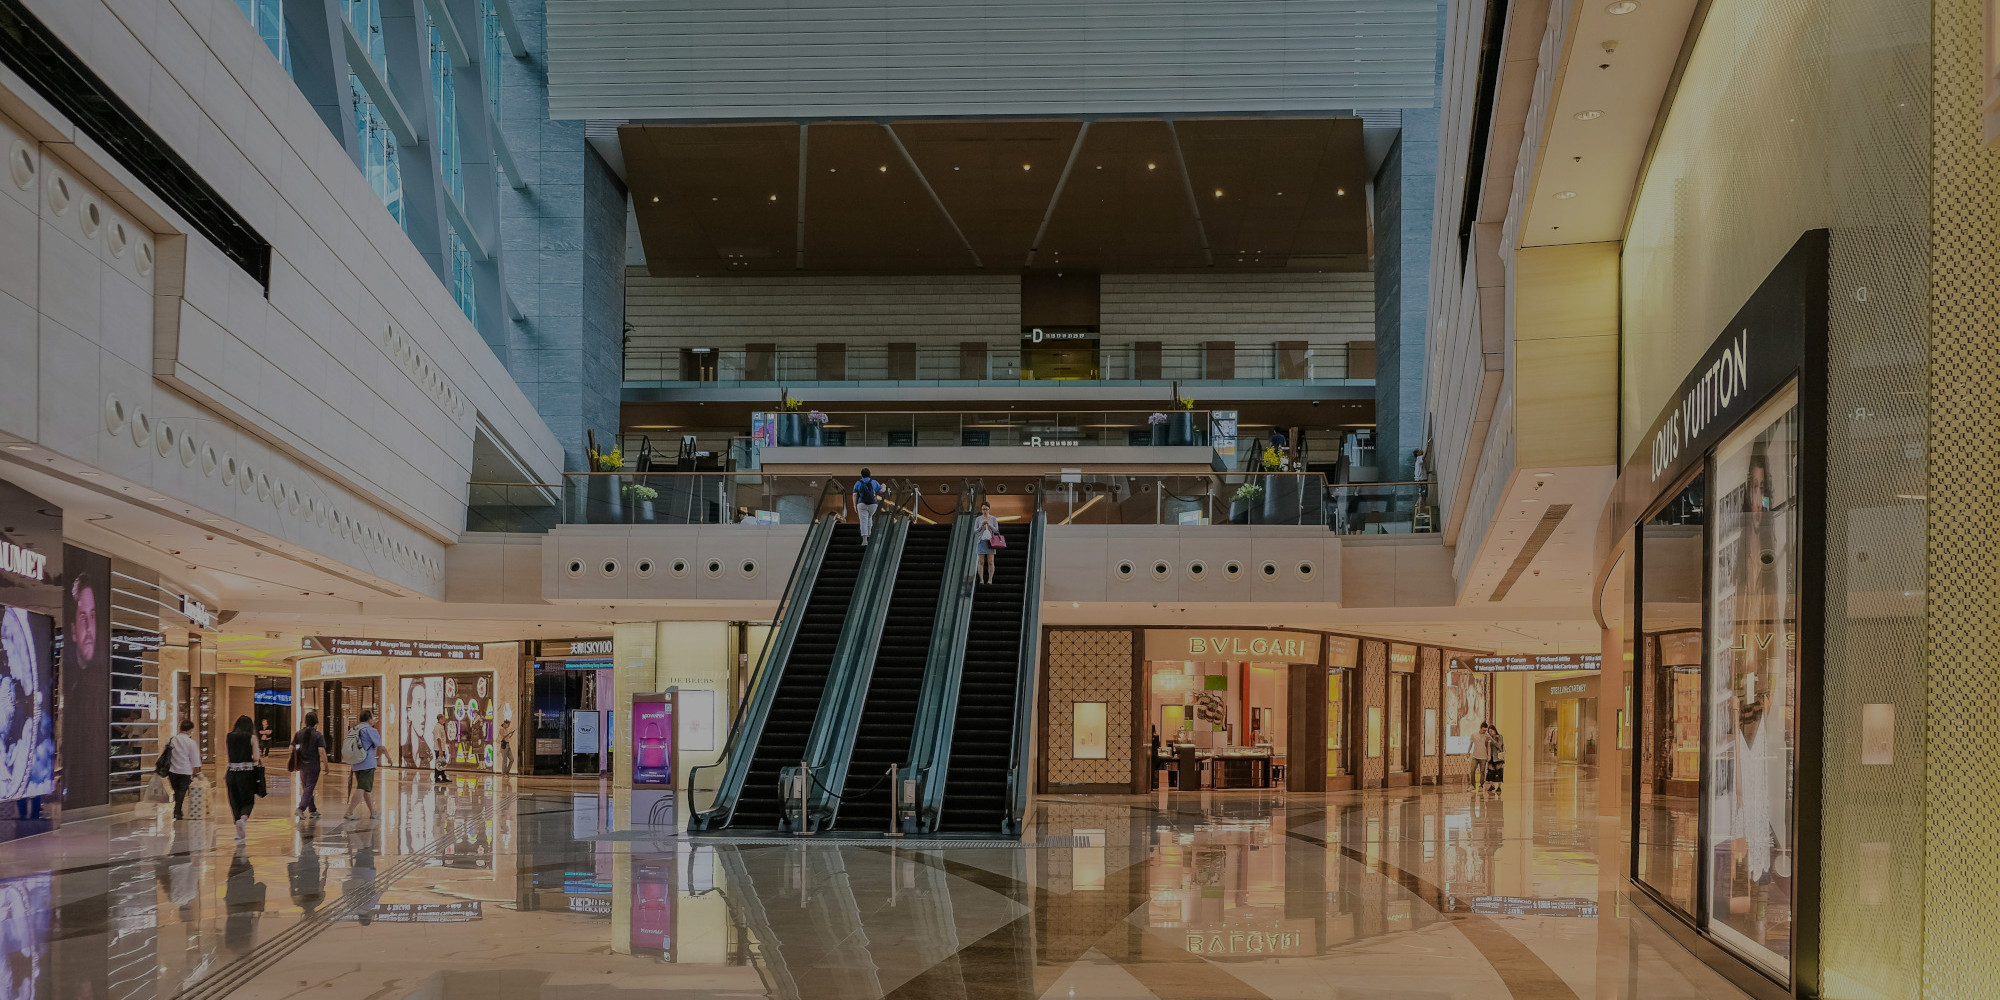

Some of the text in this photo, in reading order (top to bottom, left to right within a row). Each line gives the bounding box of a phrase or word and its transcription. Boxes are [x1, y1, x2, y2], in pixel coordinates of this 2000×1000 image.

[1032, 328, 1043, 342] D
[1651, 328, 1747, 483] LOUIS VUITTON
[1189, 637, 1304, 656] BVLGARI
